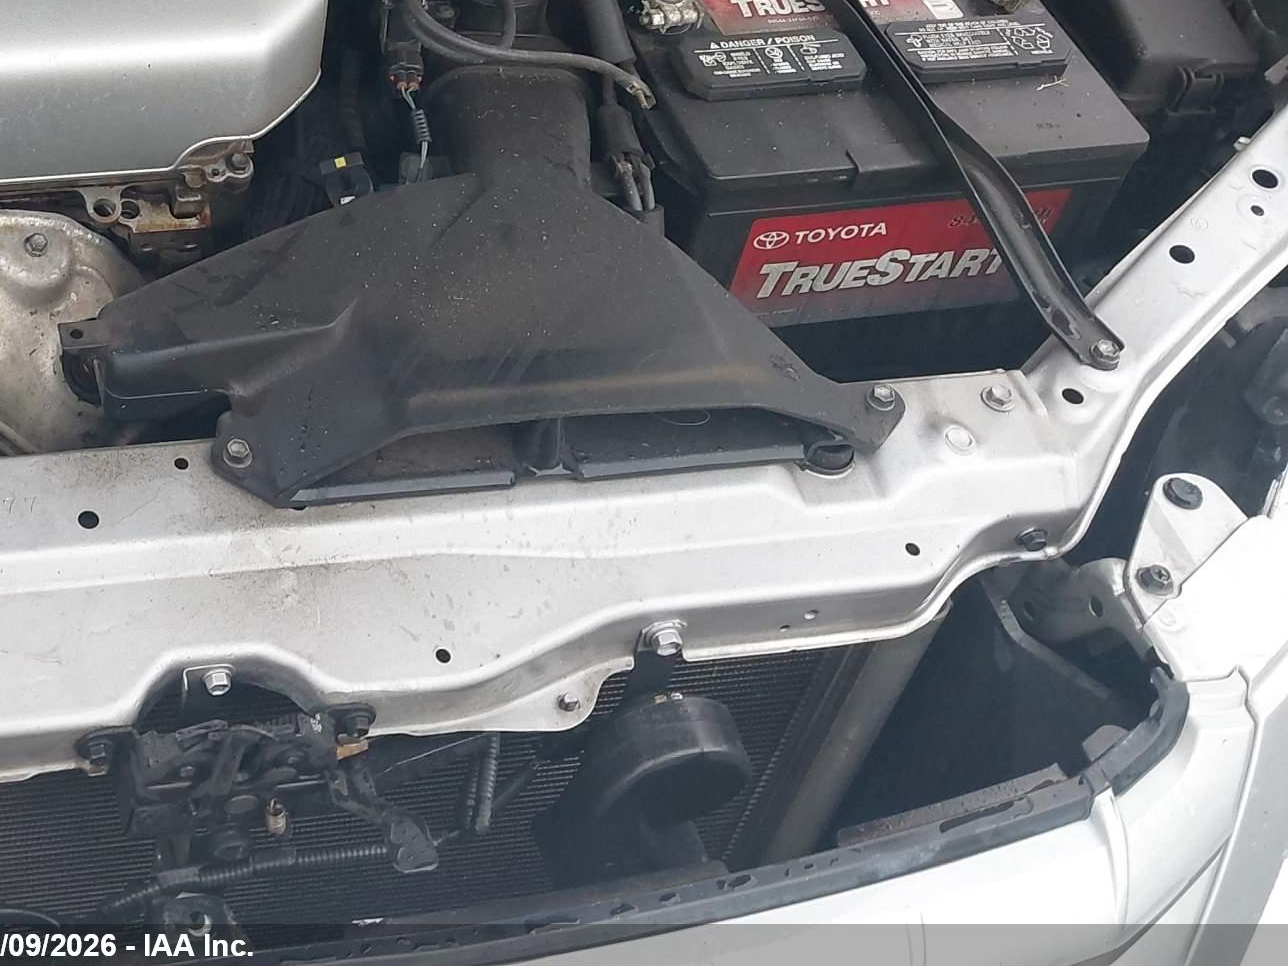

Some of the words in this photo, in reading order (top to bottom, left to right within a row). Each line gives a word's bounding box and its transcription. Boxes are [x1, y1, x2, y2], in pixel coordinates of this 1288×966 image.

[720, 38, 765, 49] DANGER
[775, 35, 816, 44] POISON
[794, 222, 888, 245] TOYOTA
